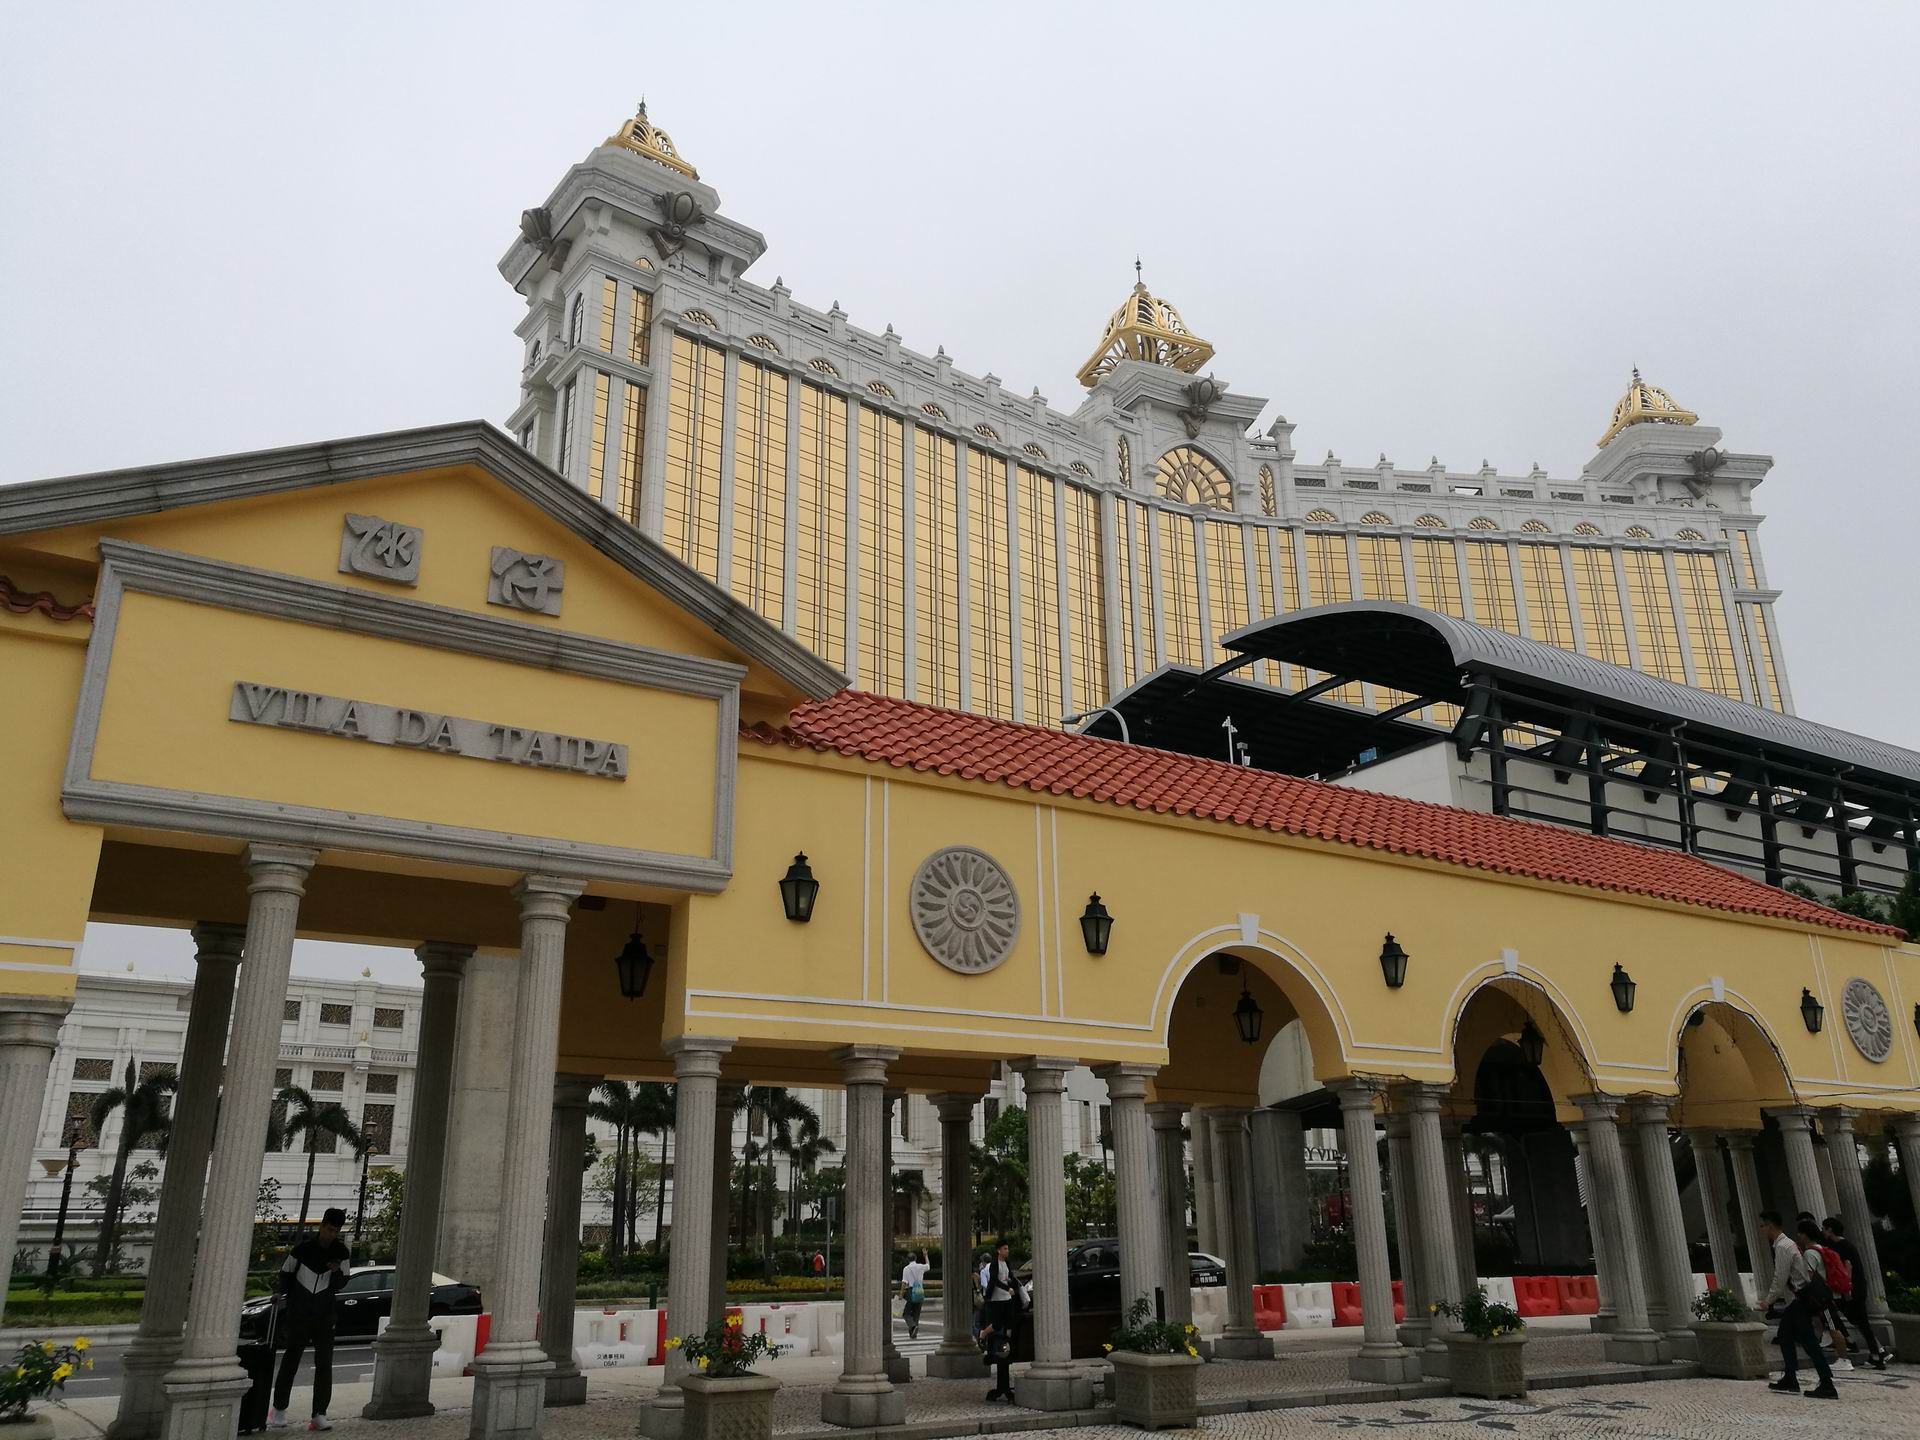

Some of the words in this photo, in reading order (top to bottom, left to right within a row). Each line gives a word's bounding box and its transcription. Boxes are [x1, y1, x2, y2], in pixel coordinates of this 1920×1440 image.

[237, 684, 368, 738] VILA
[395, 710, 461, 753] DA
[489, 725, 627, 778] TAIPA
